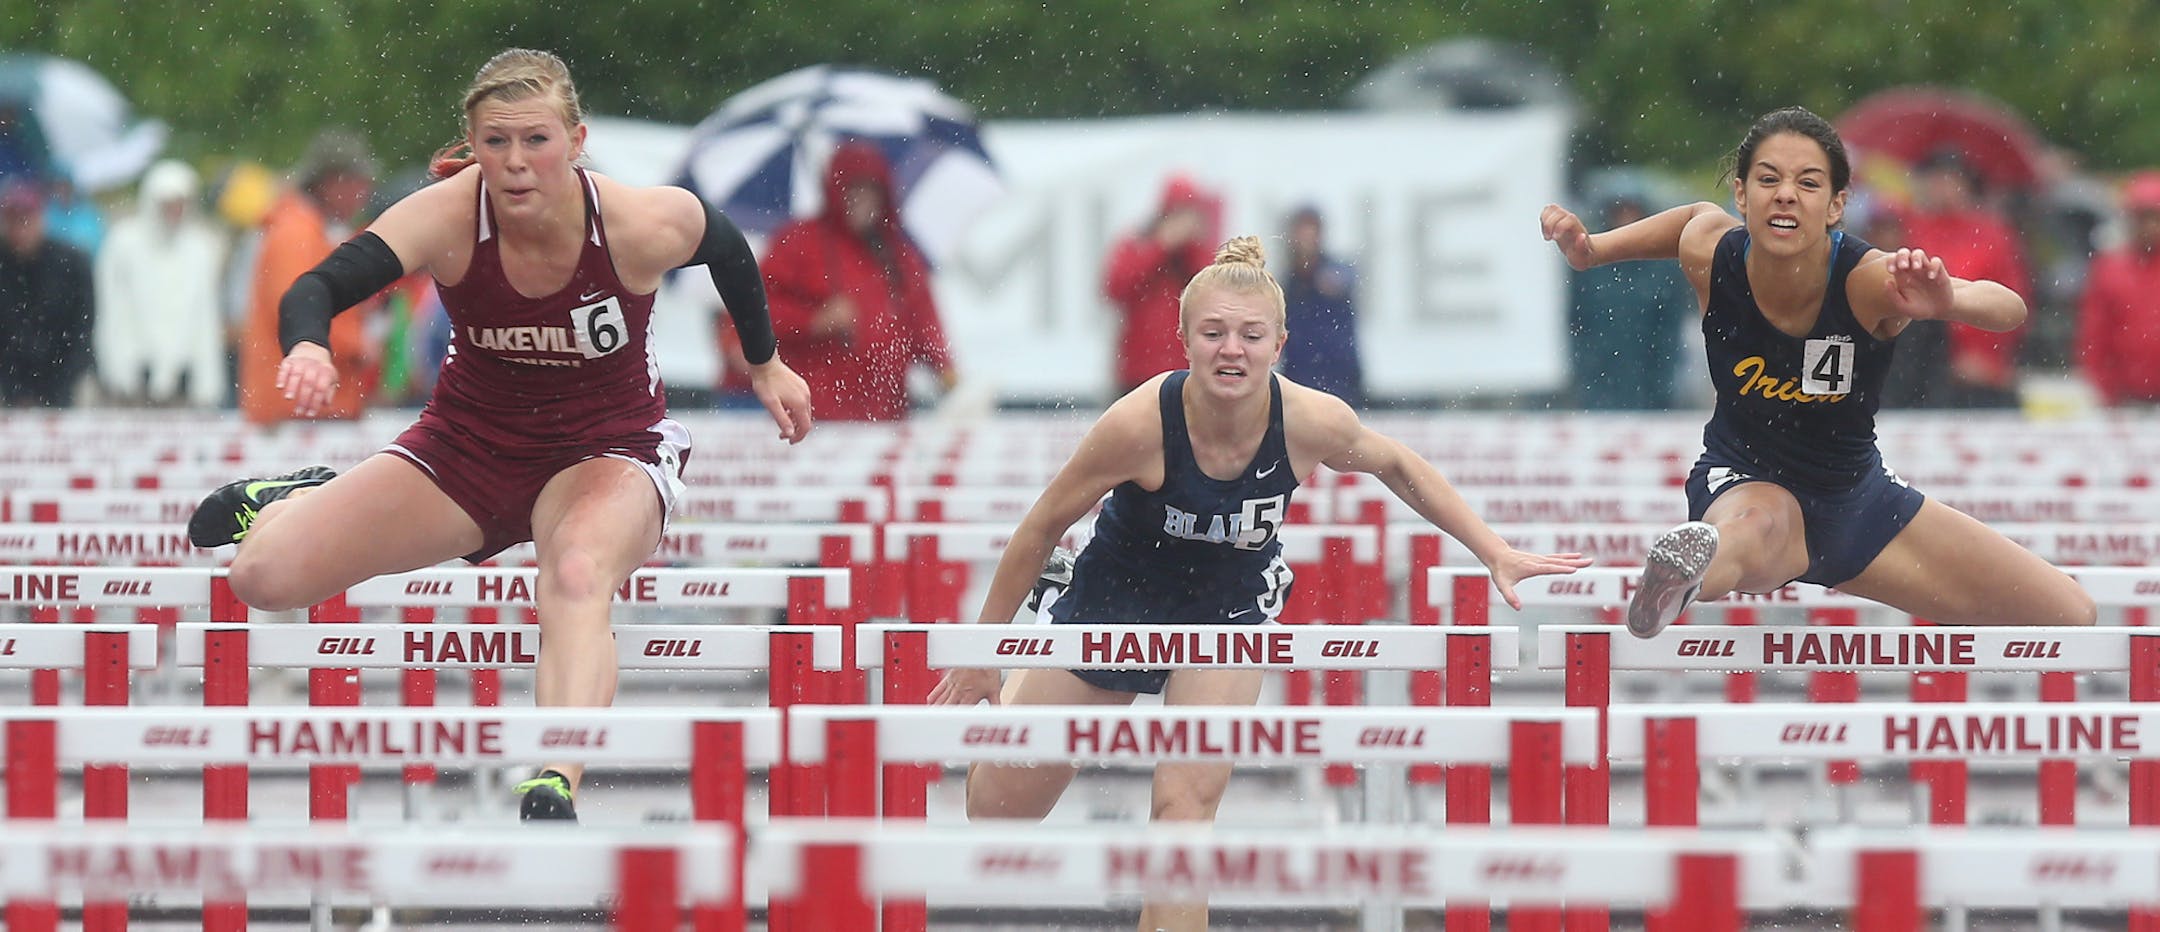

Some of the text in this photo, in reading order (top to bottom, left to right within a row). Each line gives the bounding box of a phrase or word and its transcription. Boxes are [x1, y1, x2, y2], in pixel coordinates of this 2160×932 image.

[467, 326, 583, 354] LAKEVIL
[587, 305, 619, 353] 6
[1811, 345, 1844, 391] 4
[1247, 502, 1276, 548] 5
[57, 533, 213, 556] HAMLIN
[103, 580, 152, 596] GILL
[405, 580, 453, 595] GILL
[681, 582, 730, 597] GILL
[1548, 580, 1597, 595] GILL
[317, 631, 702, 664] GILL HAML GILL
[996, 631, 1380, 664] GILL HAMLINE GILL
[1677, 632, 2062, 665] GILL HAMLINE GILL
[143, 720, 608, 755] GILL HAMLINE GILL
[962, 719, 1427, 755] GILL HAMLINE GILL
[1780, 716, 2141, 751] GILL HAMLINE
